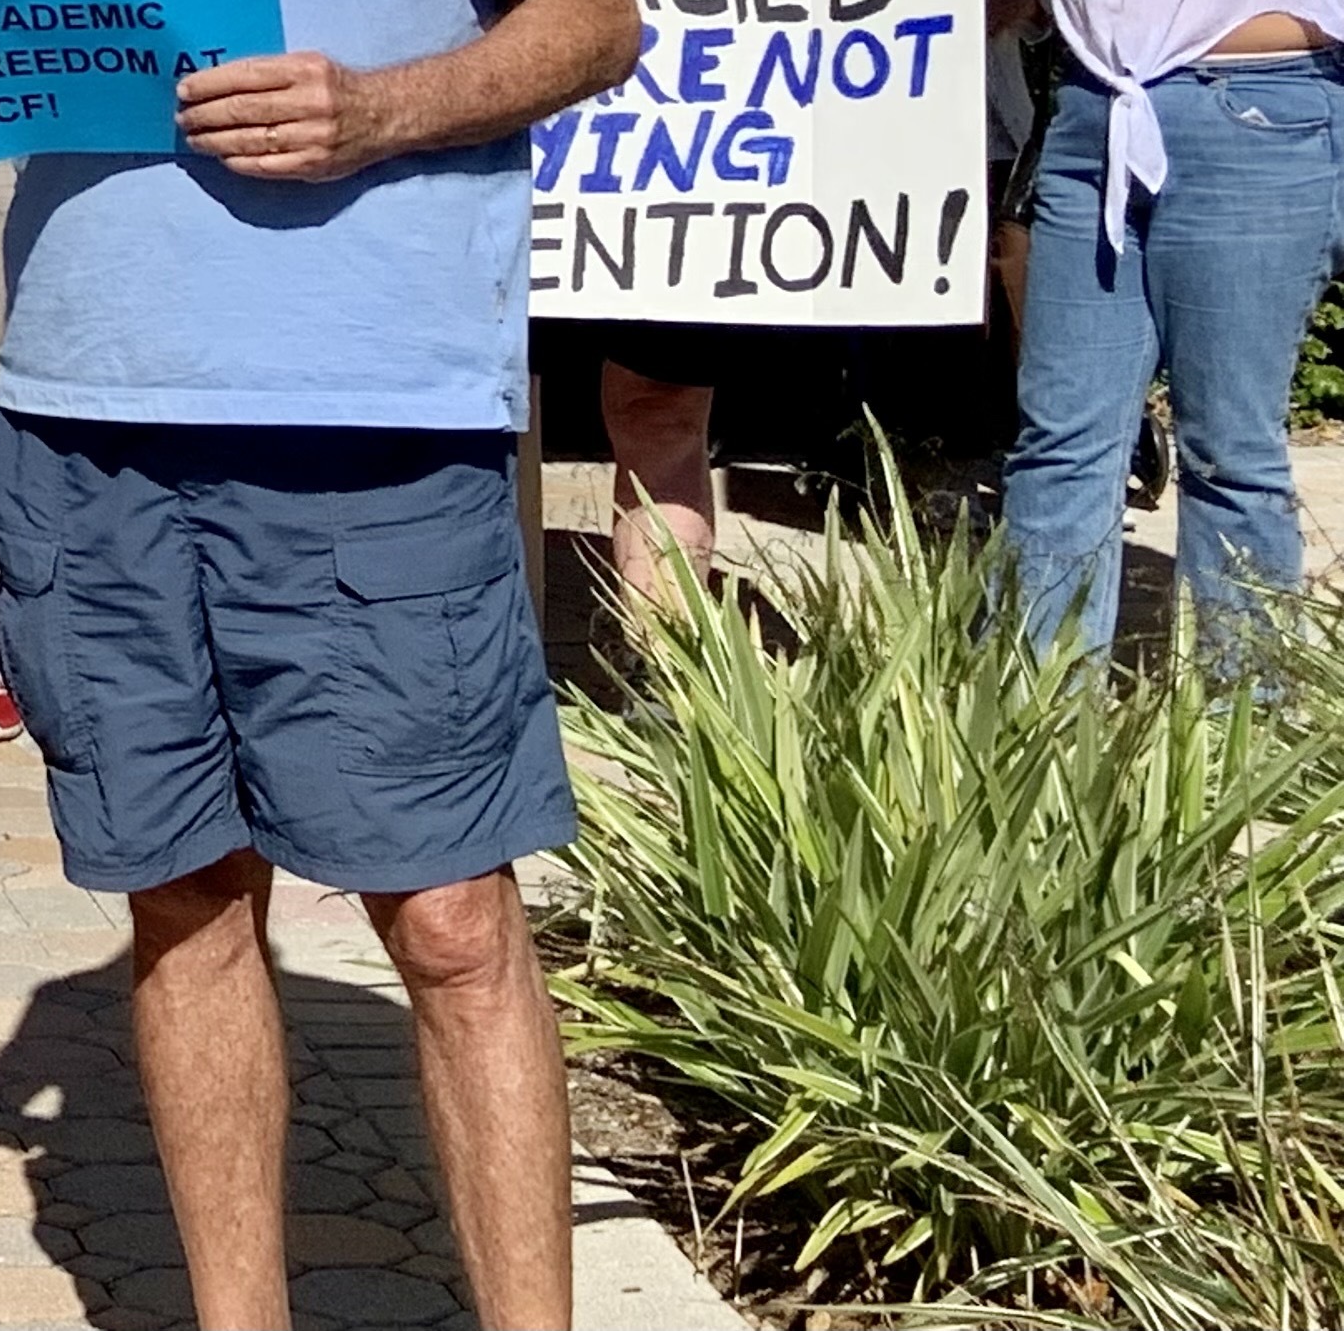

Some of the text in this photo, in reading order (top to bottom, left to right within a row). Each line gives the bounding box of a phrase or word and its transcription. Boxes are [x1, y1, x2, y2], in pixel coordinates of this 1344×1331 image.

[595, 15, 954, 108] RE NOT
[531, 110, 795, 194] YING
[529, 189, 969, 298] ENTION!
